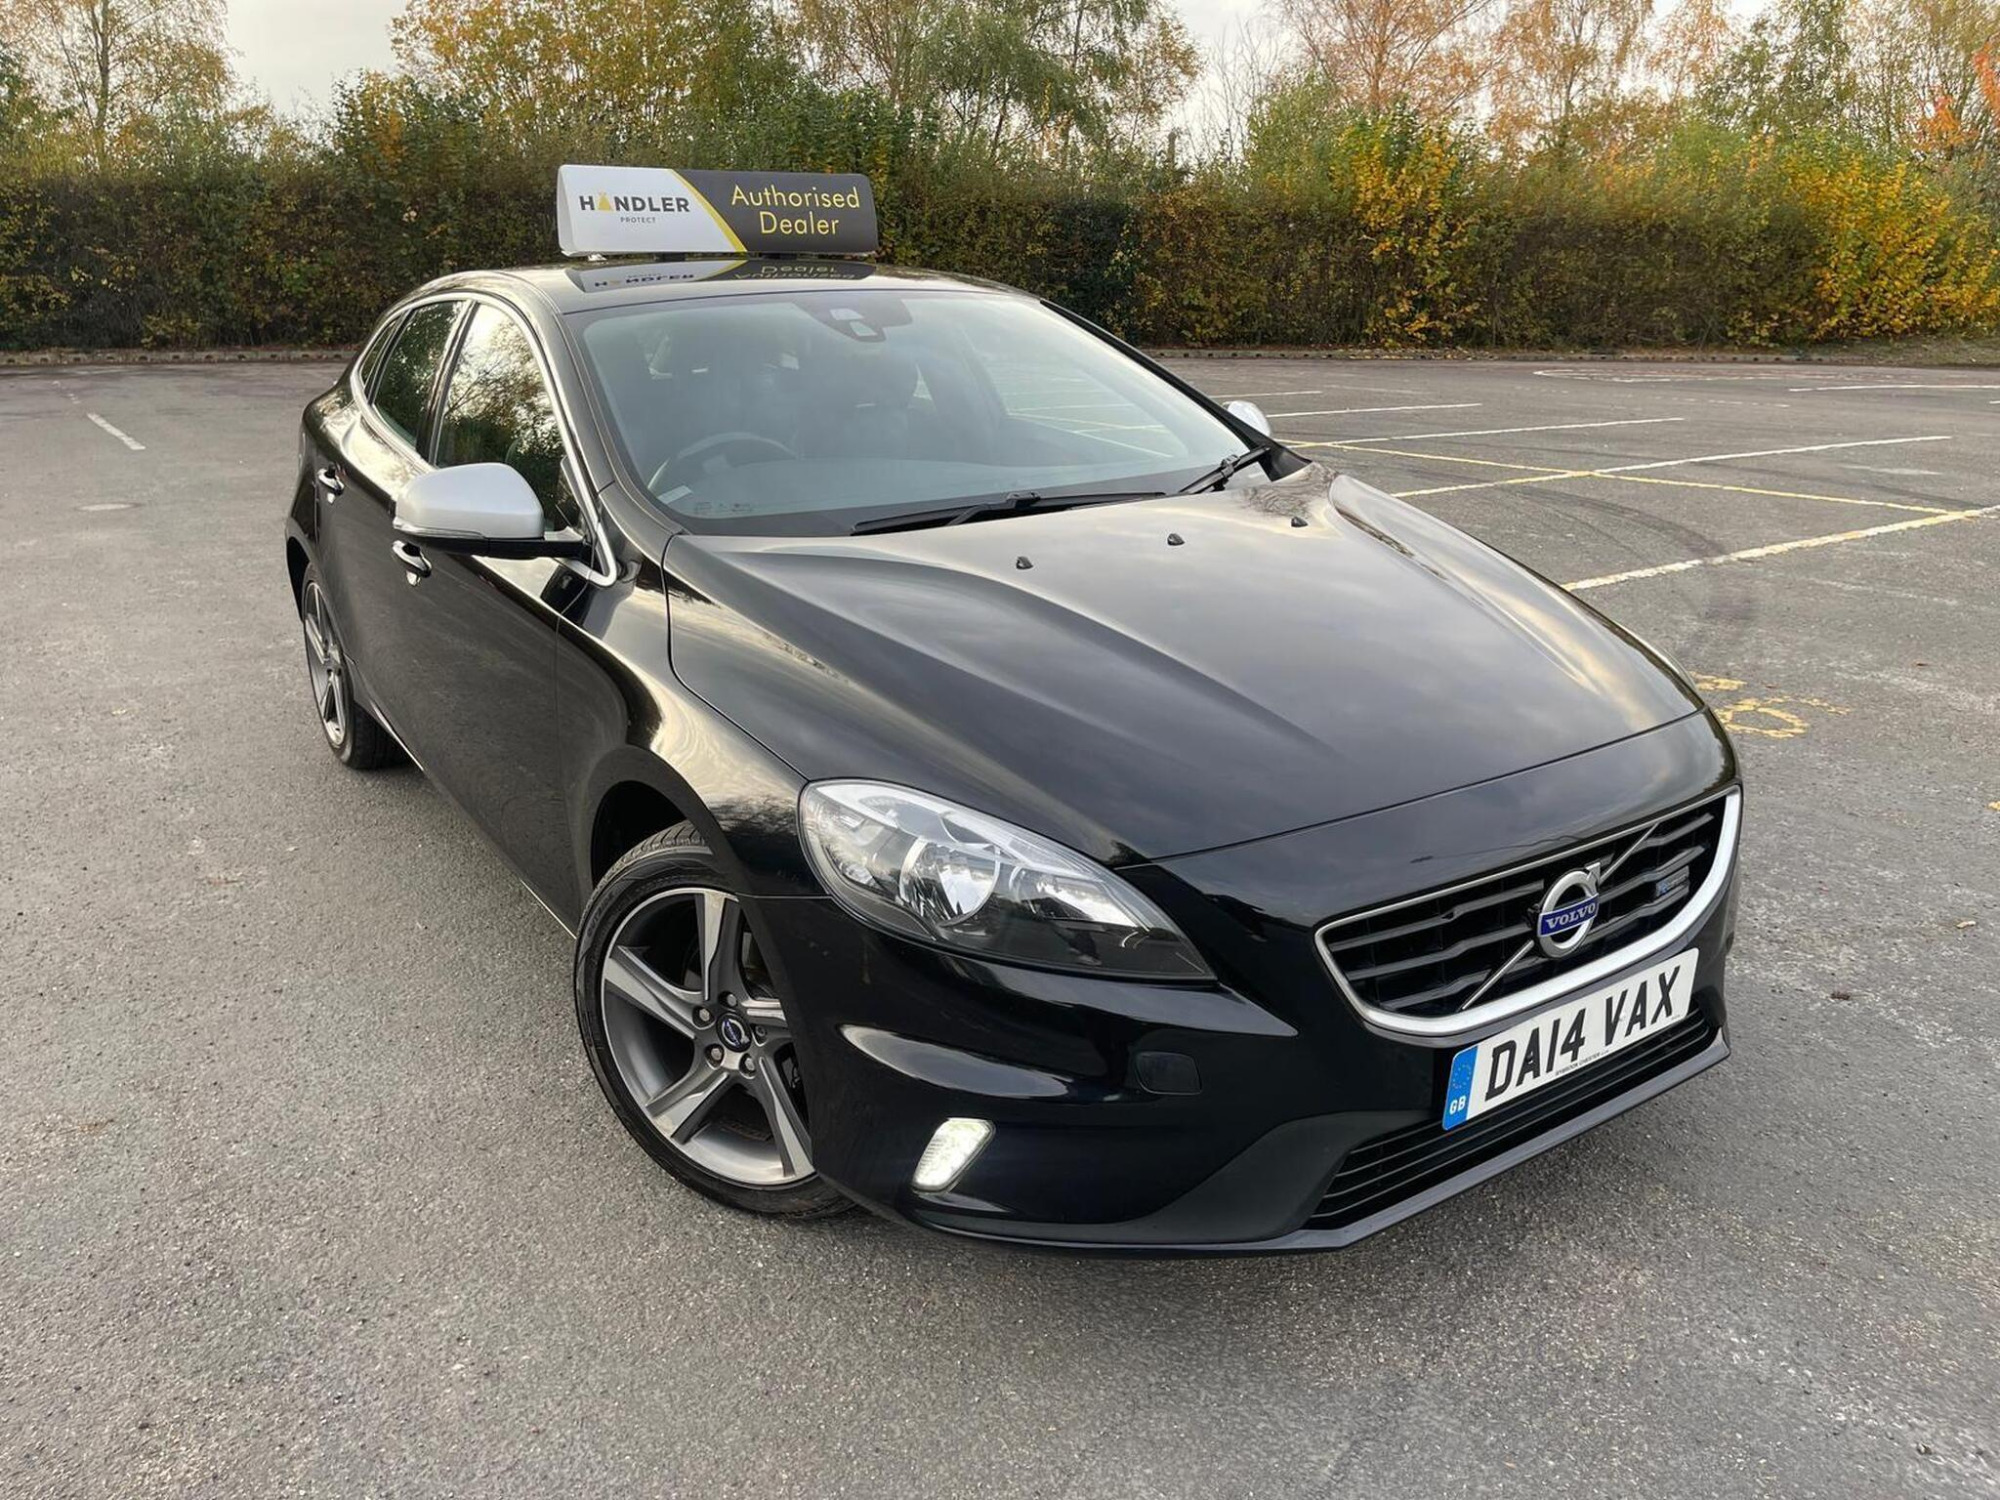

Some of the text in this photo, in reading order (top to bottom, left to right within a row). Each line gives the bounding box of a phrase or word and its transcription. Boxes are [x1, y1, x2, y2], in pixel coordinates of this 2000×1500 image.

[731, 184, 861, 209] Authorised
[759, 211, 839, 235] Dealer
[1545, 902, 1596, 929] VOLVO
[1485, 964, 1681, 1102] DA14 VAX
[1449, 1096, 1466, 1115] GB
